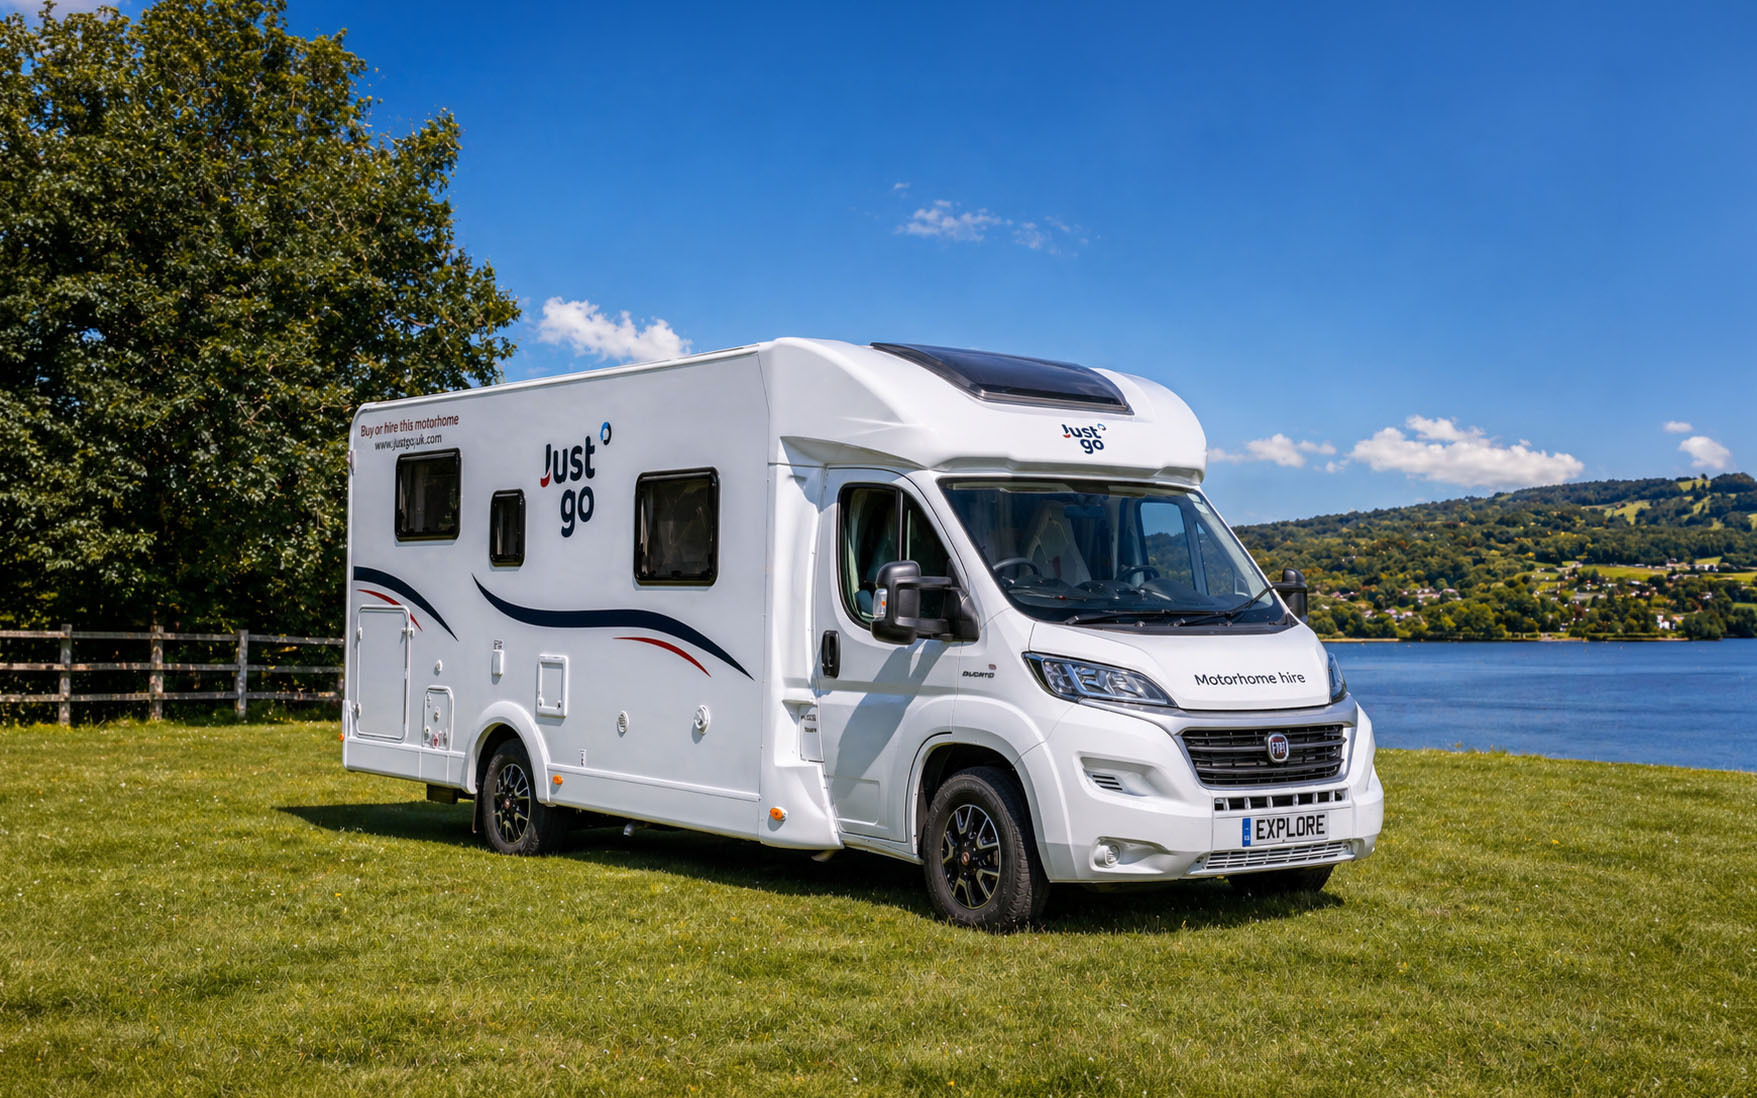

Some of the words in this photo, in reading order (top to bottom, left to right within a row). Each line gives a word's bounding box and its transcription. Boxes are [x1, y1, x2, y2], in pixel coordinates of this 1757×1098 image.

[360, 424, 374, 439] Buy
[375, 424, 383, 435] or
[384, 421, 398, 434] hire
[400, 418, 413, 432] this
[415, 414, 459, 430] motorhome
[1061, 423, 1102, 439] Just
[1080, 439, 1104, 454] go
[540, 435, 596, 488] Just
[560, 486, 595, 538] go
[1194, 672, 1277, 686] Motorhome
[1278, 671, 1306, 684] hire
[1256, 814, 1325, 841] EXPLORE
